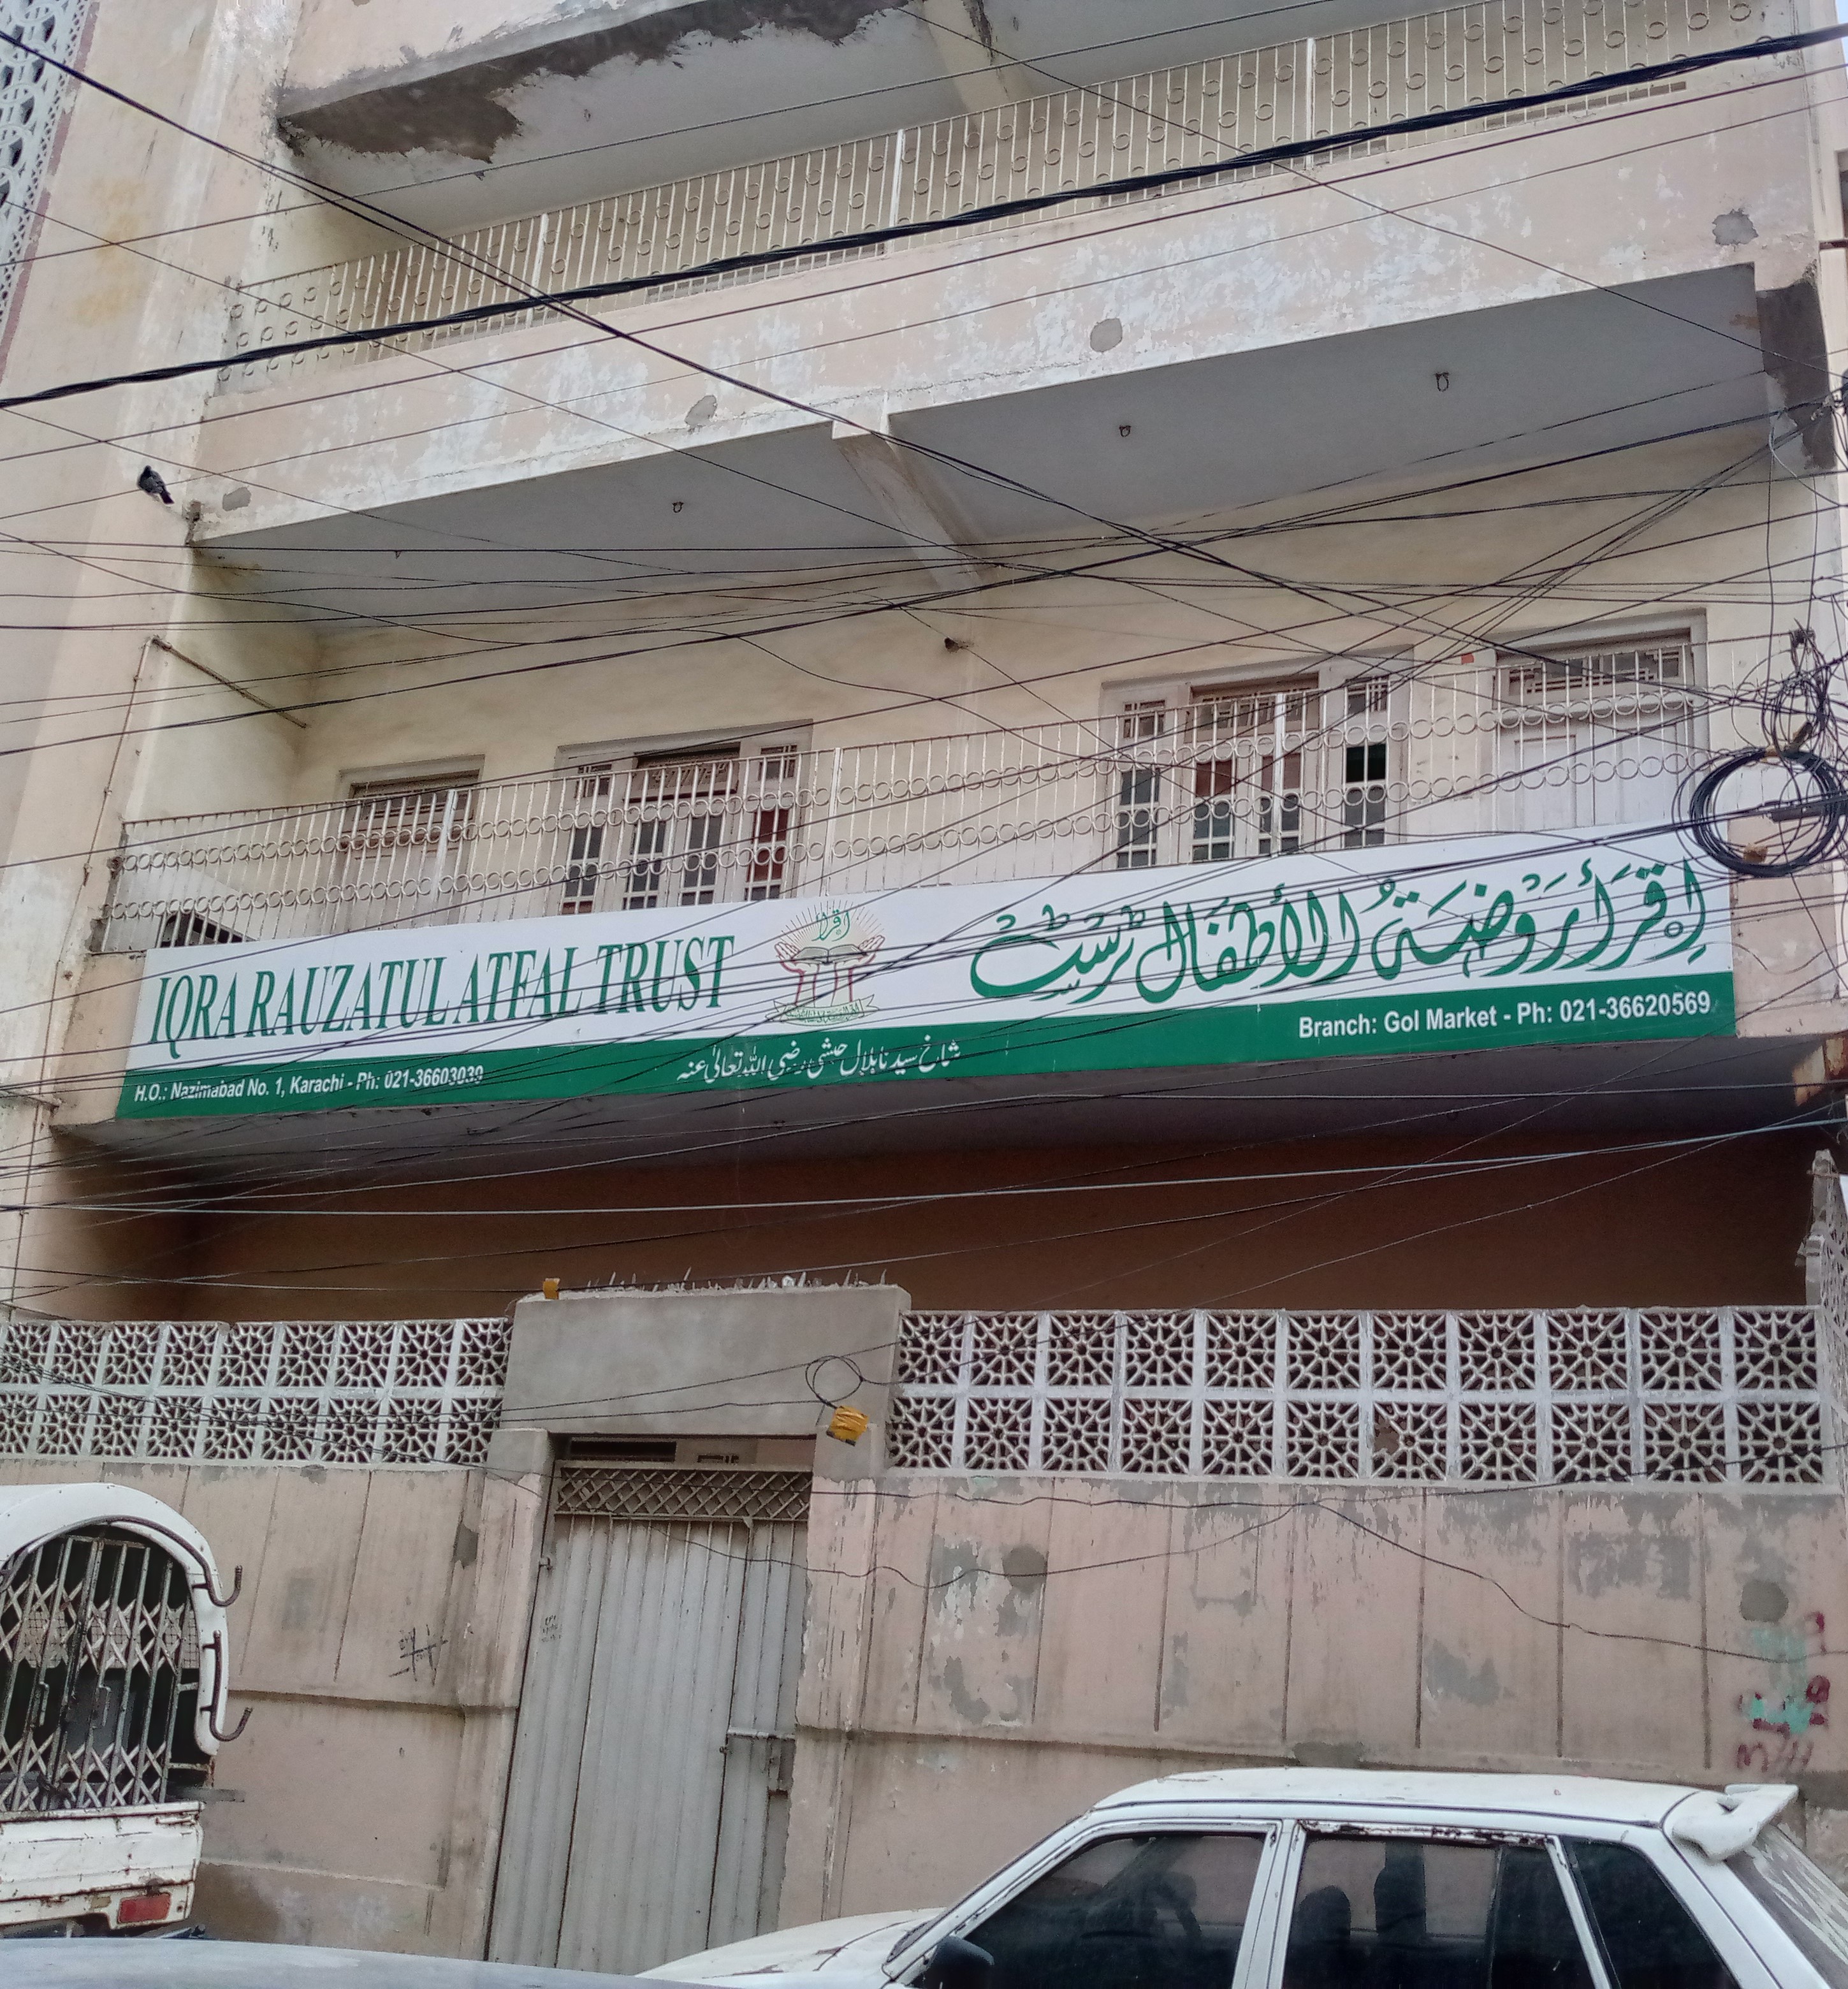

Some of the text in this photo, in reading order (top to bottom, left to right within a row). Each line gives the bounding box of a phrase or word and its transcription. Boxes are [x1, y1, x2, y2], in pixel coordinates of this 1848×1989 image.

[148, 935, 735, 1059] IQRA RAUZATUL ATFAL TRUST
[1299, 1013, 1376, 1038] Branch:
[1384, 1010, 1419, 1033] Gol
[1427, 1005, 1497, 1030] Market
[1517, 1002, 1552, 1024] Ph:
[1560, 990, 1710, 1023] 021-36620569
[840, 1038, 878, 1076] بلال
[171, 1079, 245, 1100] Nazimabad
[247, 1078, 269, 1096] No.
[276, 1077, 285, 1098] 1,
[289, 1074, 344, 1094] Karachi
[356, 1072, 380, 1090] Ph:
